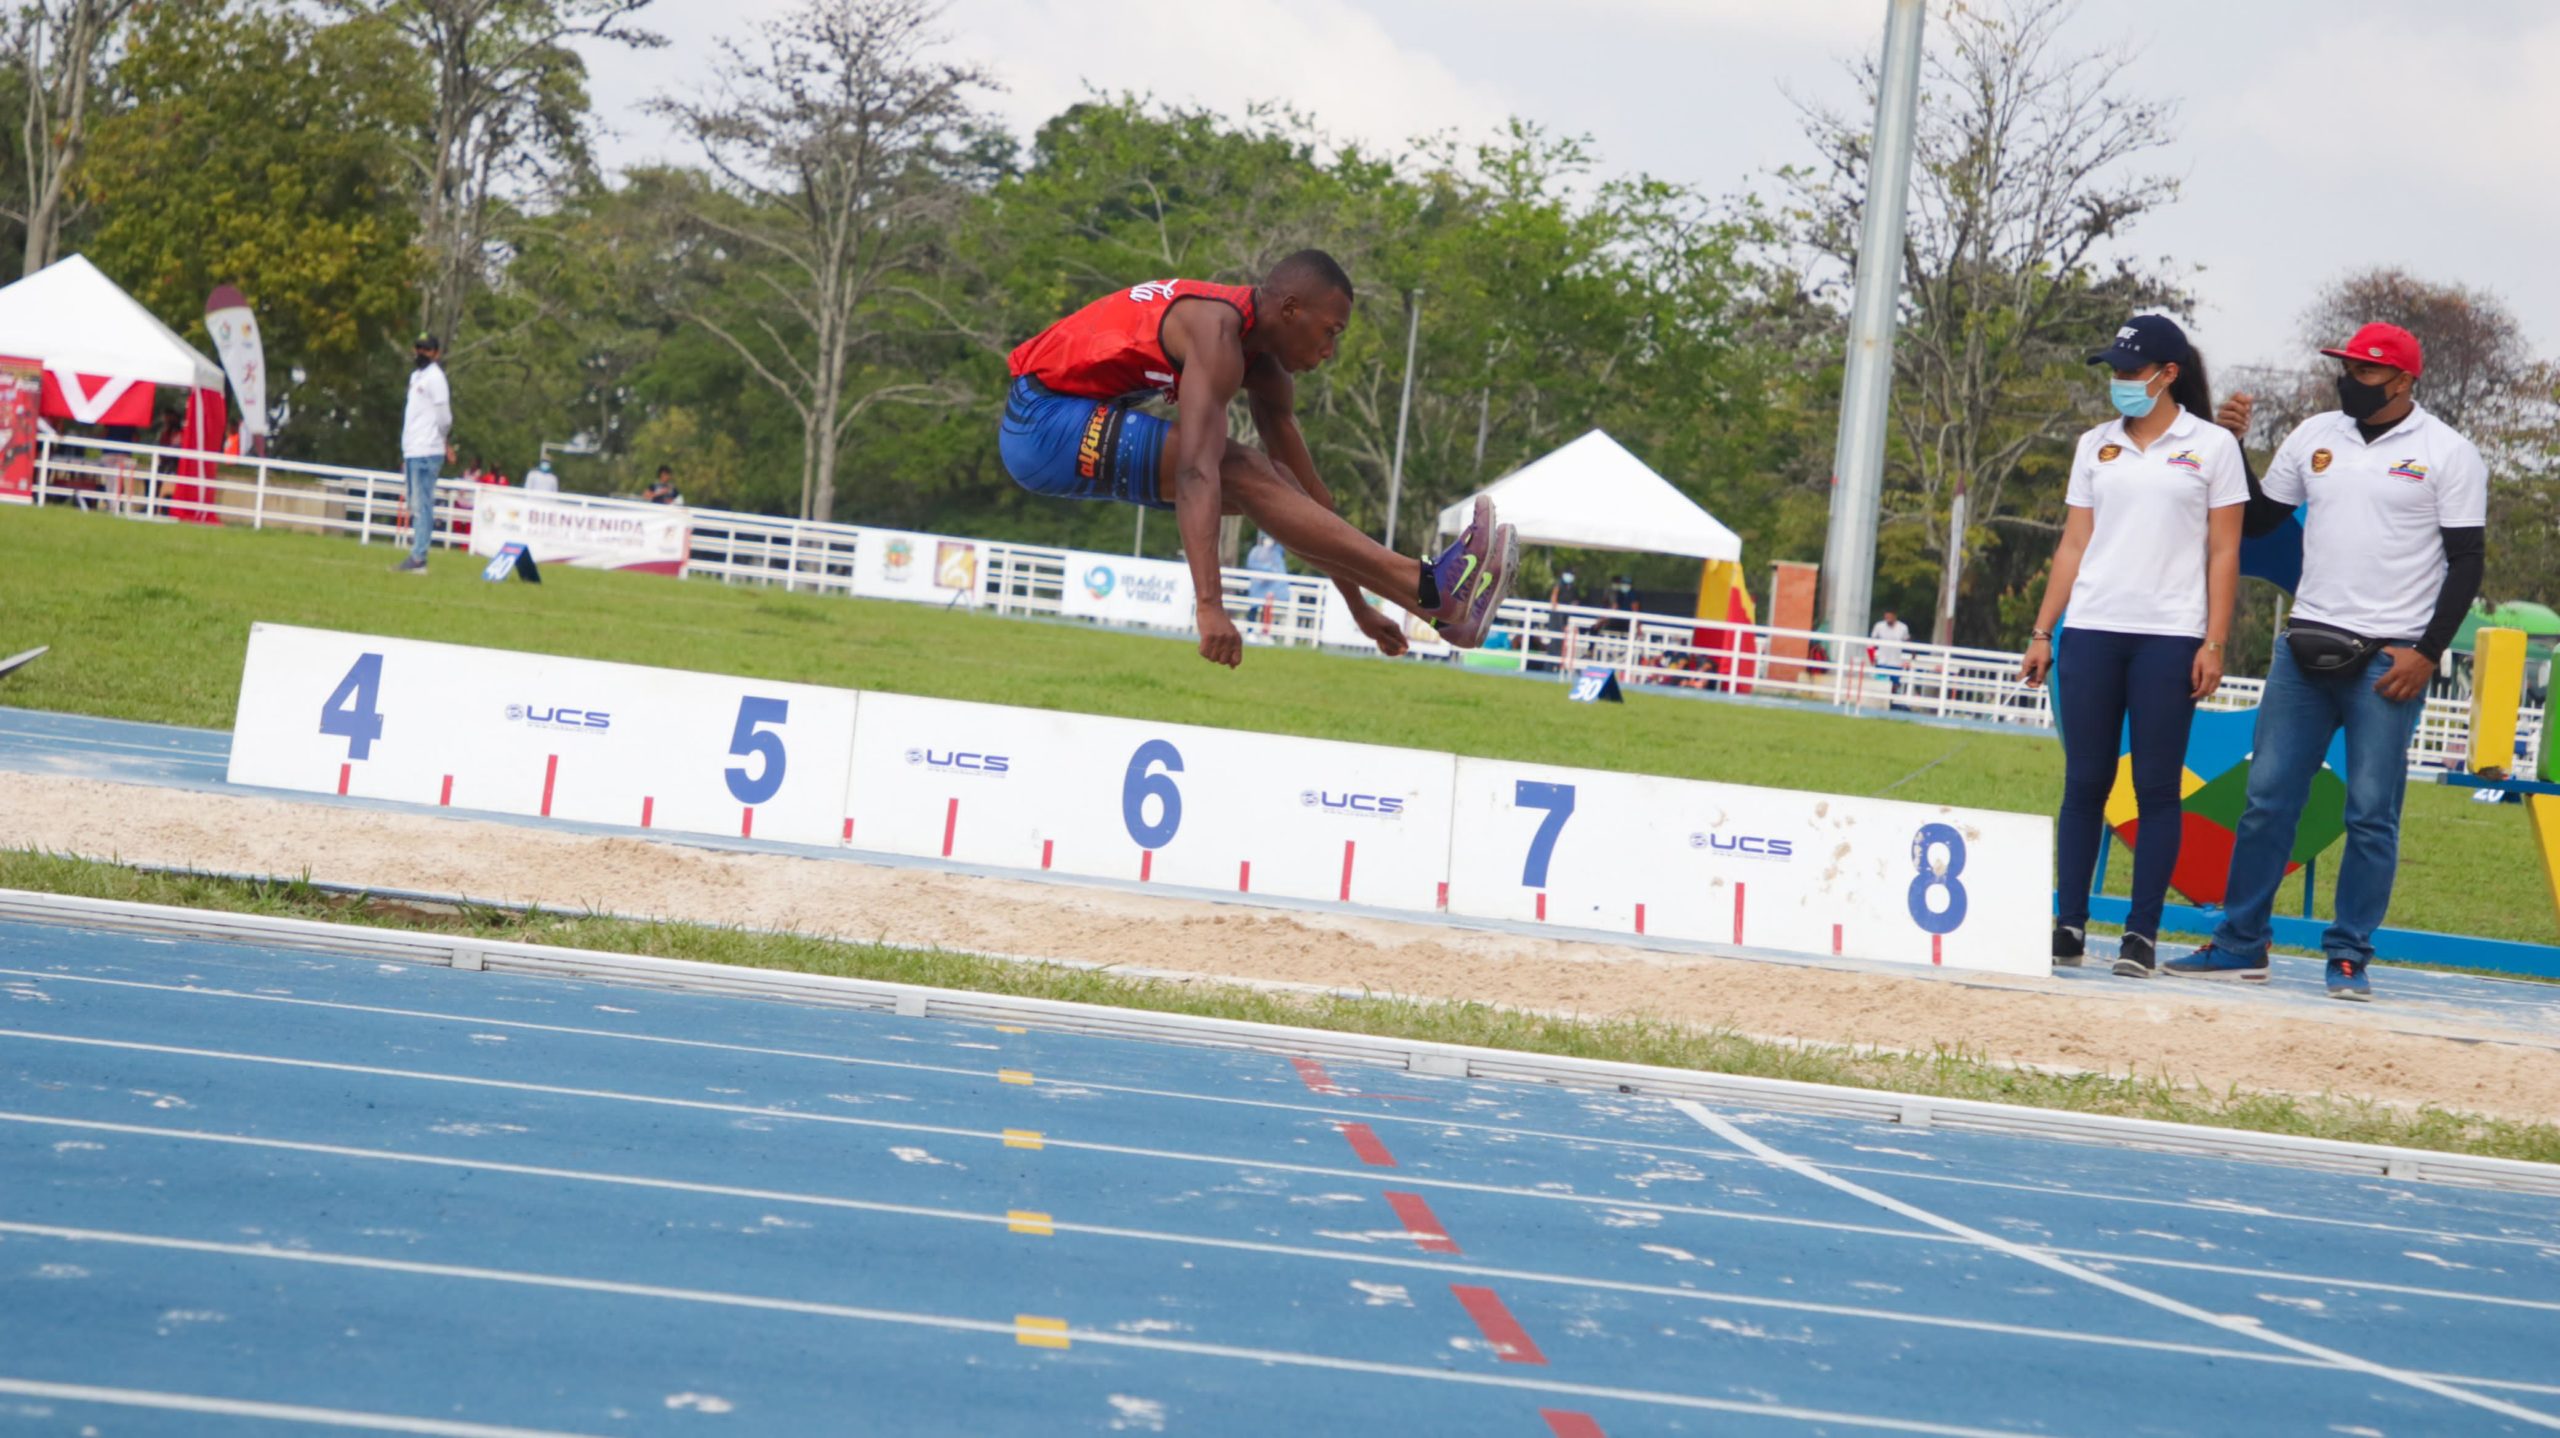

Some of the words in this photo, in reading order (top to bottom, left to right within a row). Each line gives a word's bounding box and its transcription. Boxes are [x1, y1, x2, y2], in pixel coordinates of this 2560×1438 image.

[527, 508, 645, 535] BIENVENIDA
[484, 553, 517, 580] 40
[1125, 586, 1172, 605] VIBRA
[1567, 677, 1604, 702] 30
[321, 653, 384, 760] 4
[526, 704, 611, 729] UCS
[725, 696, 789, 805] 5
[925, 748, 1010, 773] UCS
[1122, 740, 1185, 849] 6
[1320, 790, 1405, 814] UCS
[1514, 780, 1576, 889] 7
[1709, 832, 1793, 857] UCS
[1908, 823, 1969, 934] 8
